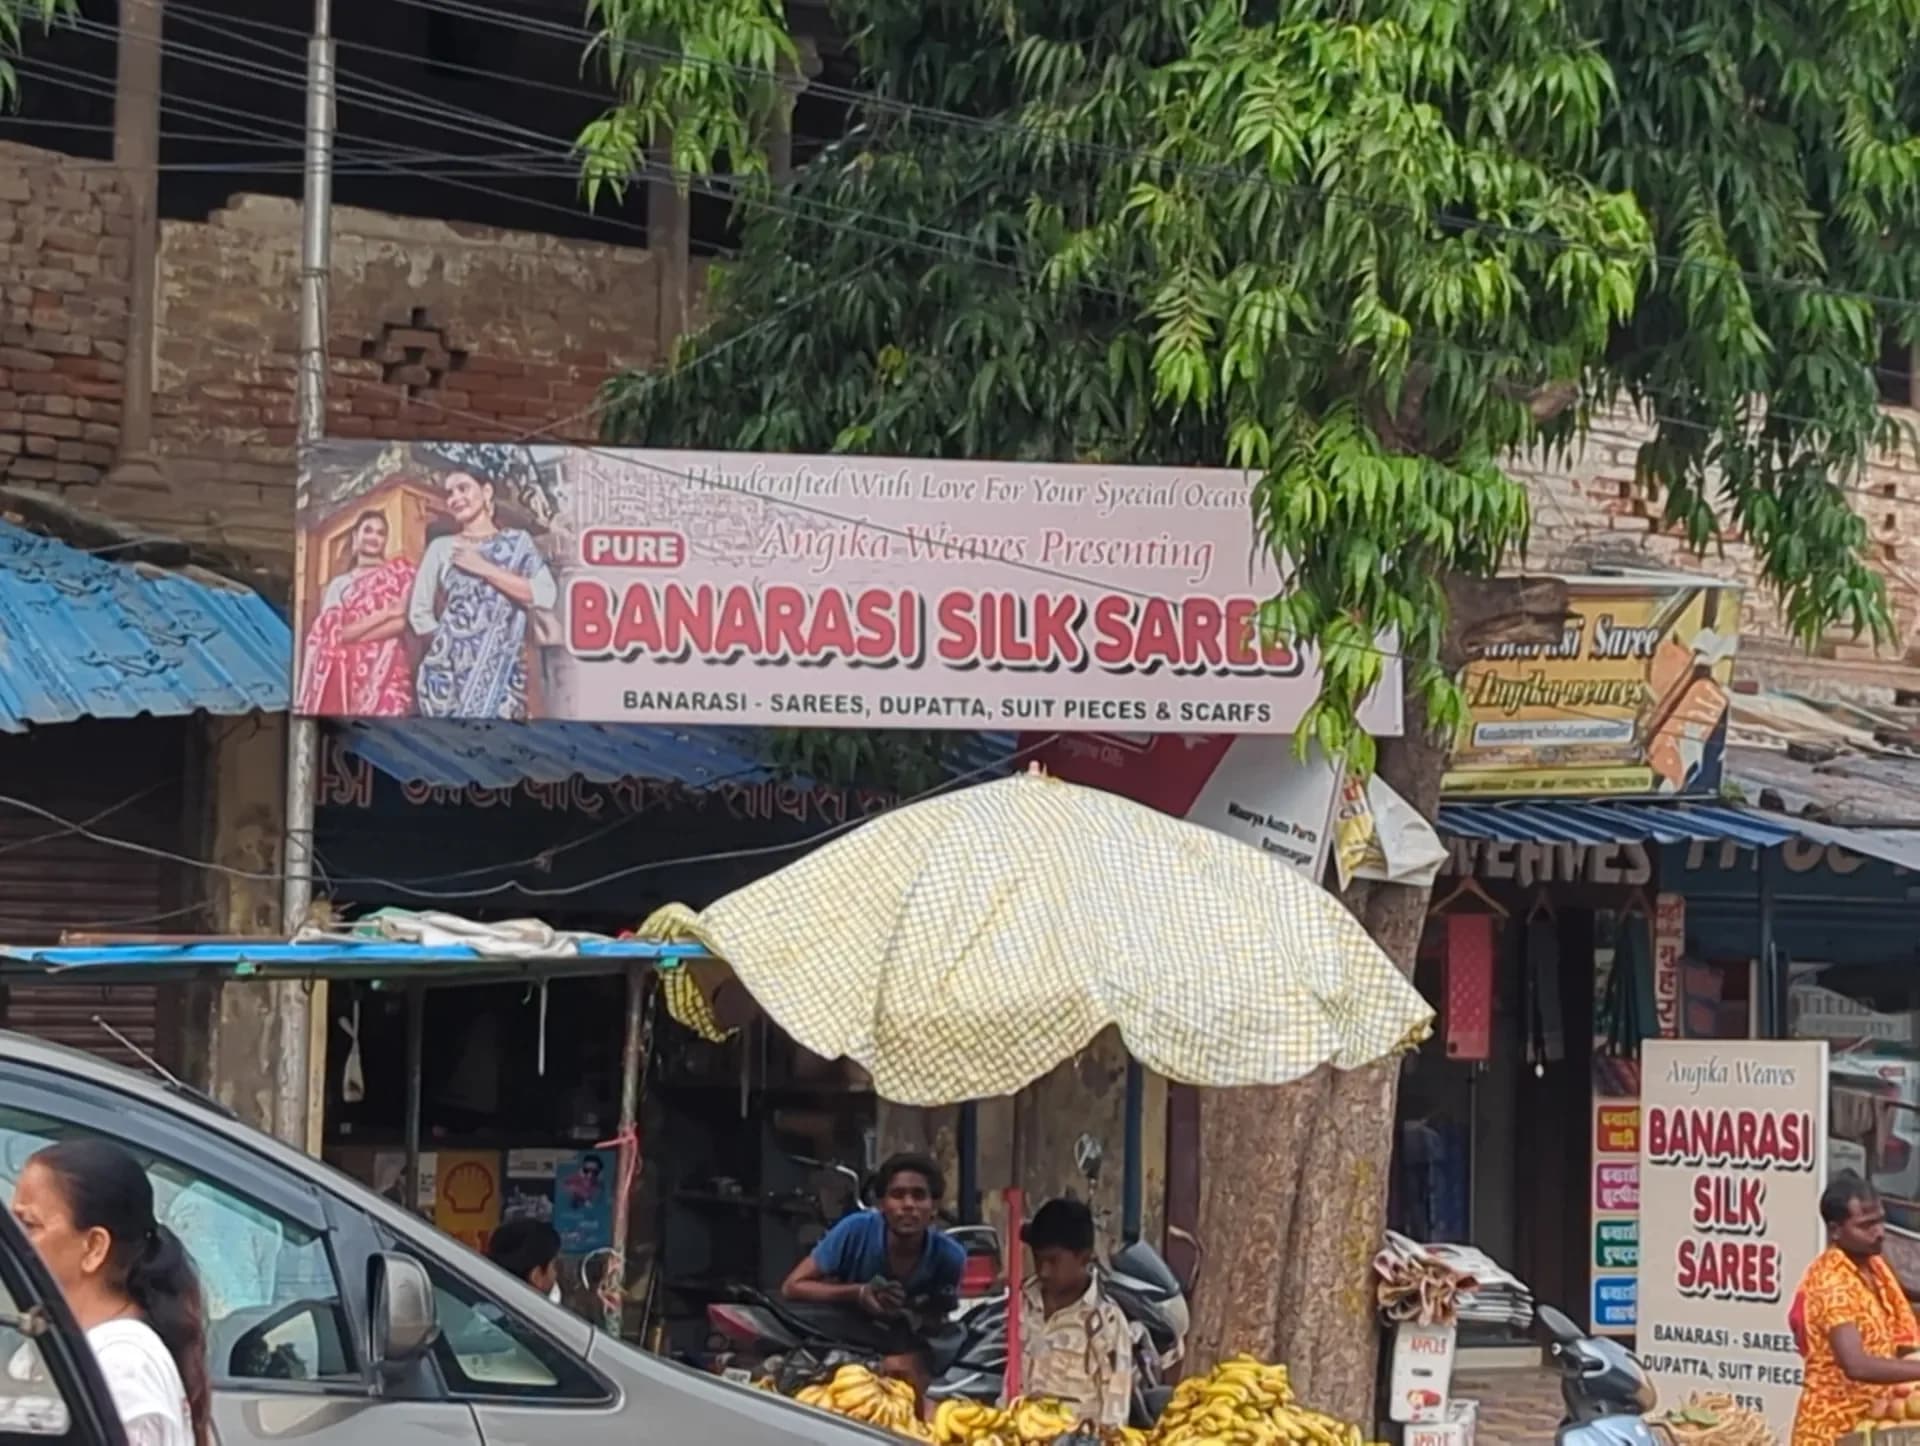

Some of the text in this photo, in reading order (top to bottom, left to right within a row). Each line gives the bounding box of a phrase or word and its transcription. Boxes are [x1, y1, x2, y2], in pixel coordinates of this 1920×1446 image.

[685, 465, 1250, 515] Handcrafted With Love For Your Special Occas
[591, 535, 680, 564] PURE
[759, 520, 1215, 584] Angika Weaves Presenting
[567, 578, 922, 666] BANARASI
[936, 589, 1083, 670] SILK
[1594, 614, 1659, 657] Saree
[623, 689, 748, 712] BANARASI
[770, 693, 871, 718] SAREES,
[879, 695, 993, 720] DUPATTA,
[1001, 699, 1055, 719] SUIT
[1064, 701, 1147, 721] PIECES
[1156, 701, 1171, 721] &
[1180, 702, 1271, 723] SCARFS
[1666, 1055, 1796, 1094] Angika Weaves
[1648, 1107, 1813, 1167] BANARASI
[1693, 1174, 1765, 1230] SILK
[1677, 1239, 1780, 1298] SAREE
[1653, 1323, 1729, 1347] BANARASI
[1743, 1331, 1797, 1352] SAREE
[1643, 1354, 1805, 1387] DUPATTA, SUIT PIECE
